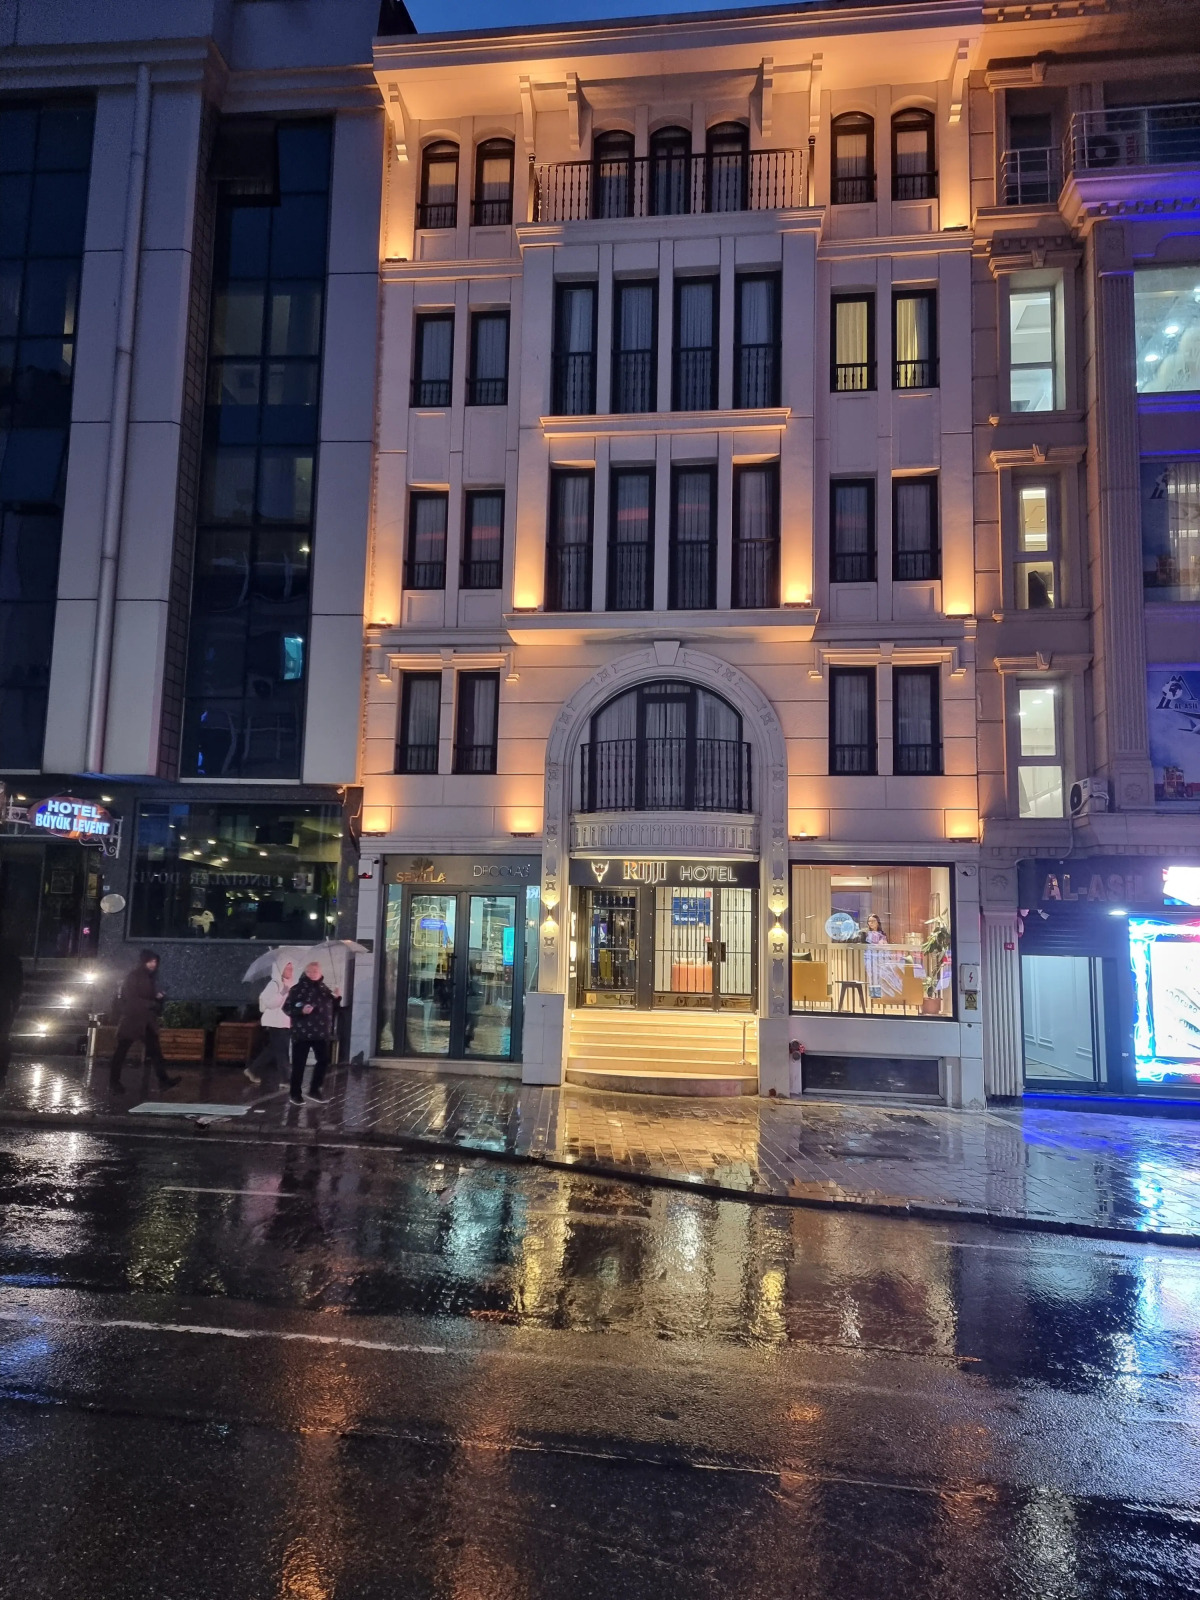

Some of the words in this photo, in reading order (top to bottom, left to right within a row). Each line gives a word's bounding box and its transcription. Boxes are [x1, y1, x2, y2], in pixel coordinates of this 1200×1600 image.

[47, 800, 101, 819] HOTEL
[35, 812, 71, 830] BÜYÜK
[73, 818, 110, 835] LEVENT
[396, 871, 446, 883] SEVILLA
[680, 865, 738, 882] HOTEL
